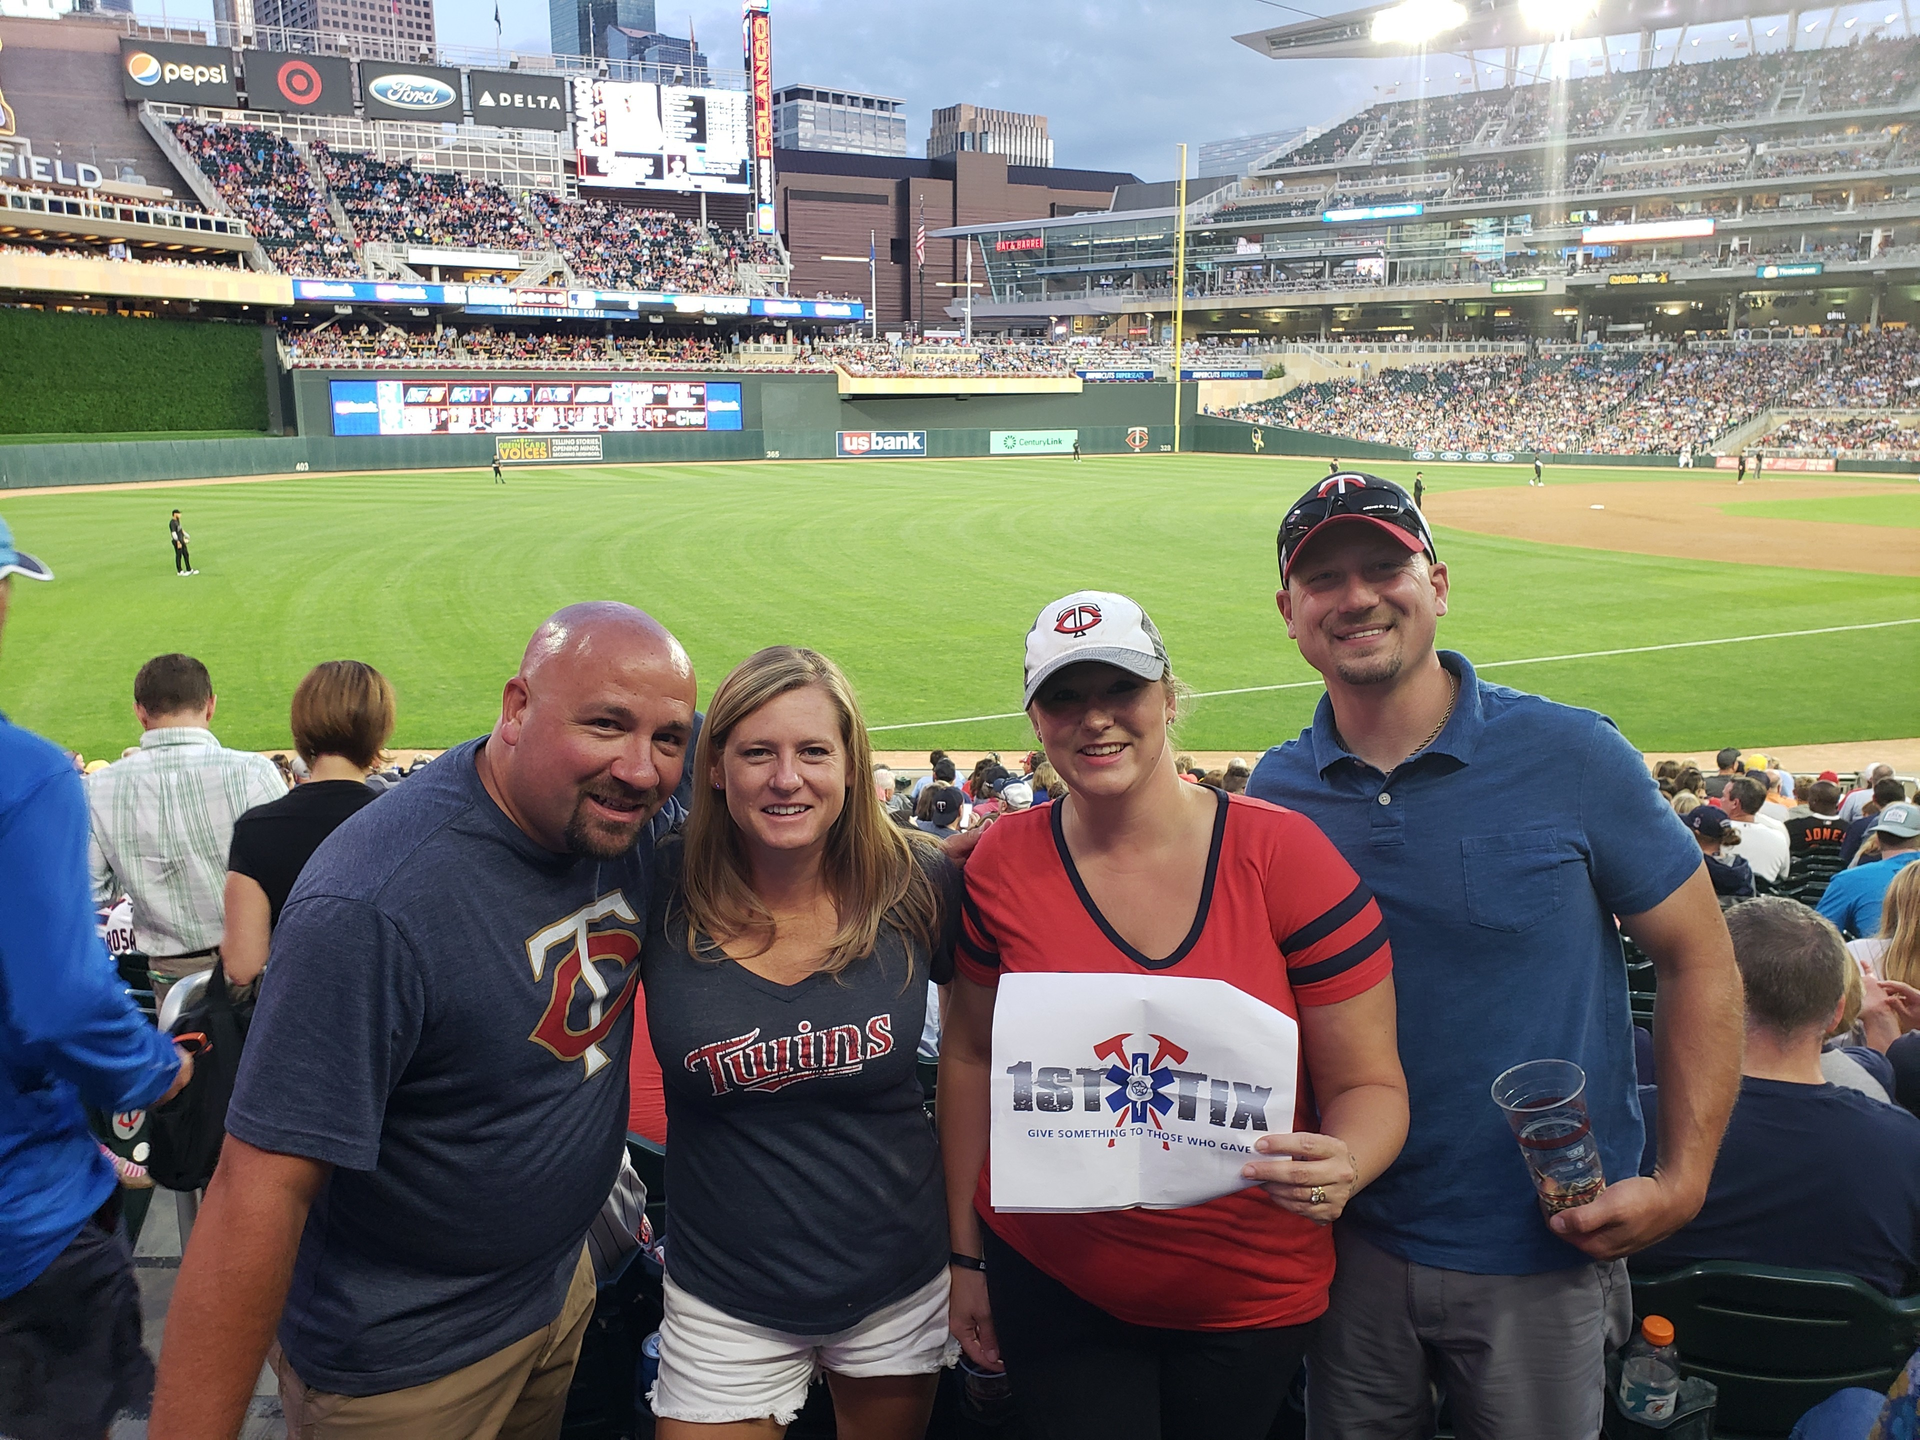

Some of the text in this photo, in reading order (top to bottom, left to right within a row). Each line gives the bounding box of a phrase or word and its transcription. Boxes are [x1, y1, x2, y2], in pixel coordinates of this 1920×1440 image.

[164, 64, 229, 86] pepsi
[387, 81, 438, 104] Ford
[754, 18, 771, 156] POLANCO
[499, 93, 561, 110] DELTA
[501, 307, 605, 317] TREASURE ISLAND COVE
[500, 446, 547, 459] VOICES
[1019, 438, 1063, 447] CenturyLink
[684, 1013, 895, 1097] Twins
[1006, 1061, 1272, 1131] 1ST TIX
[1028, 1127, 1251, 1154] GIVE SOMETHING TO THOSE WHO GAVE
